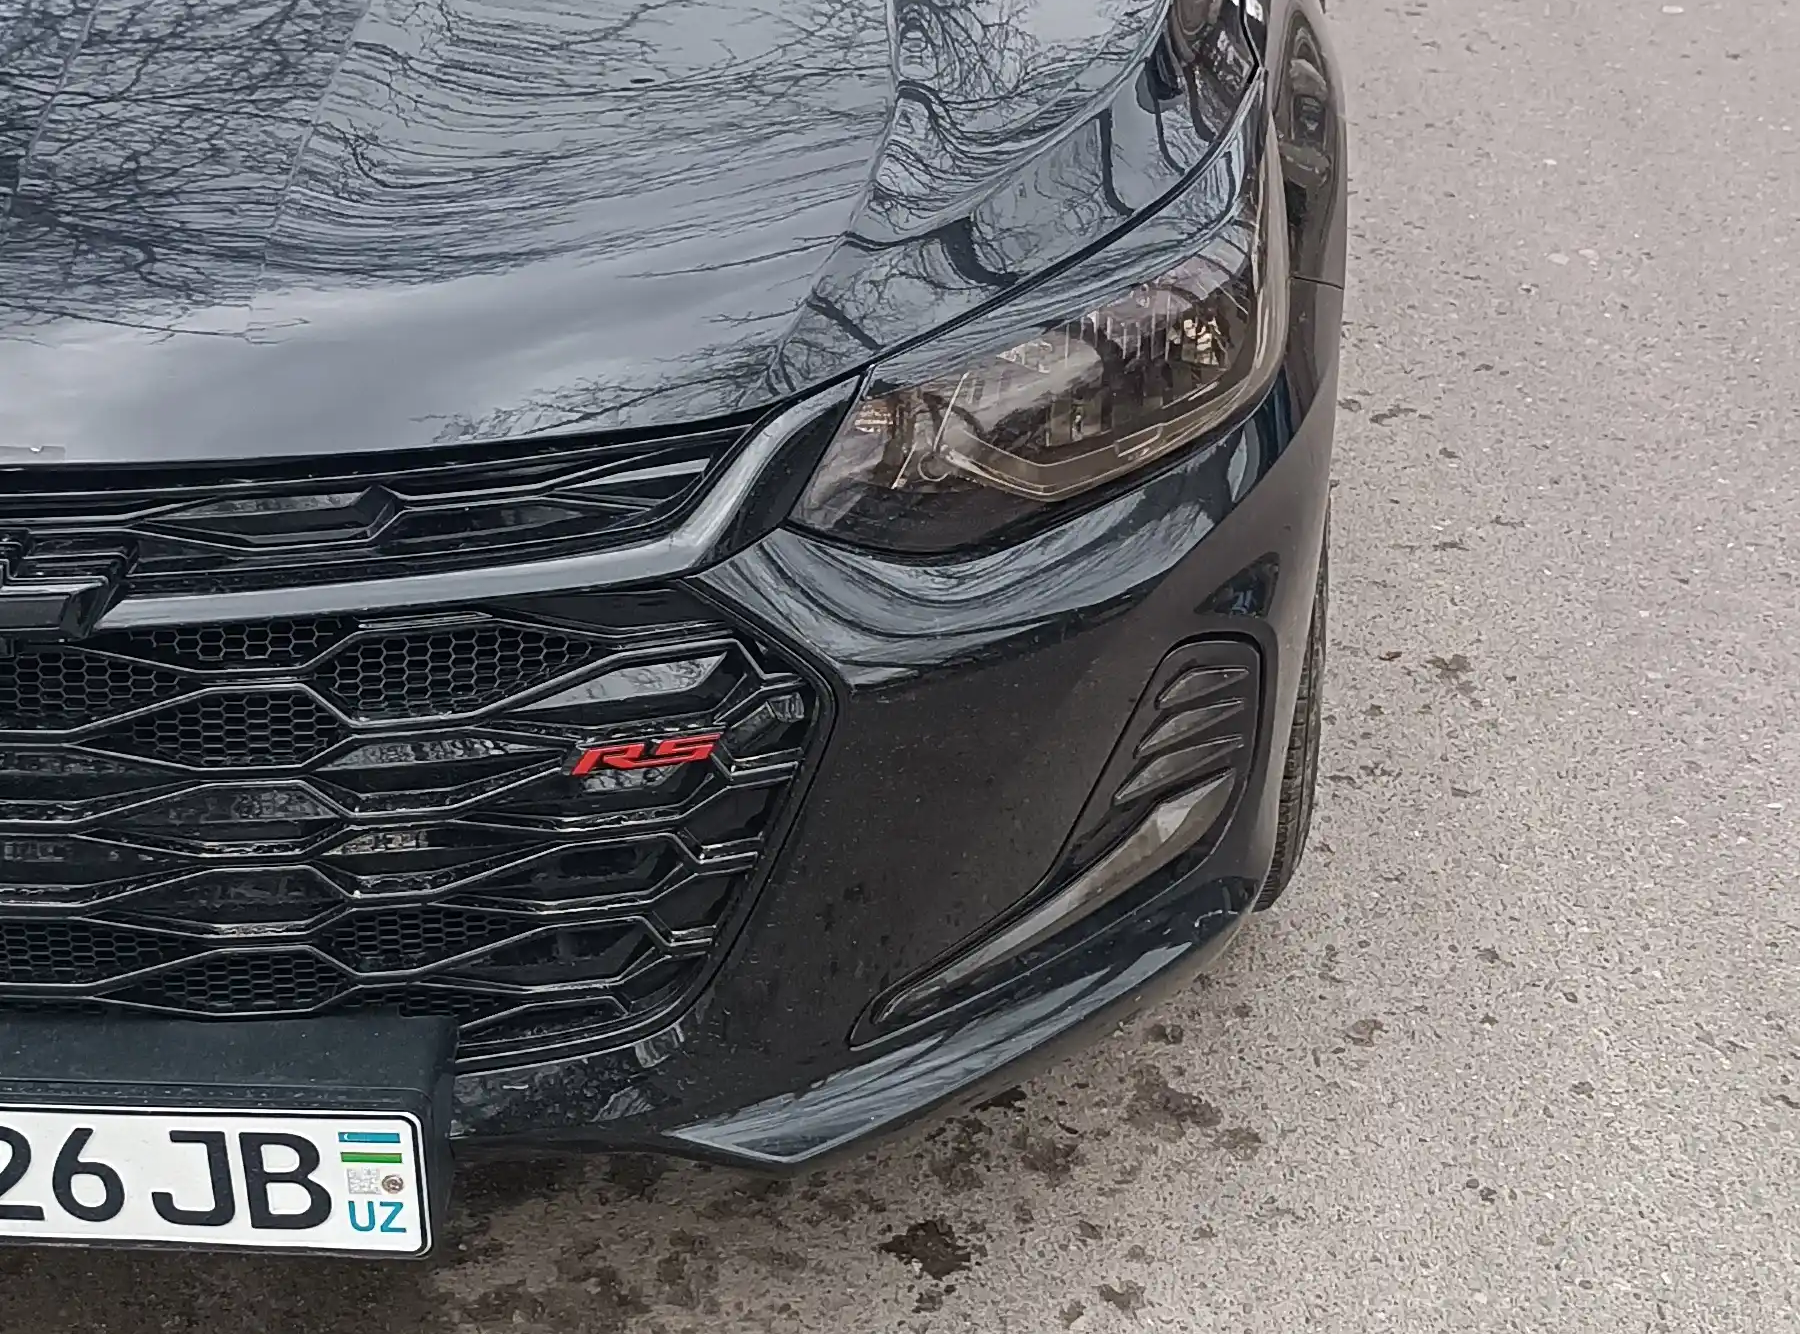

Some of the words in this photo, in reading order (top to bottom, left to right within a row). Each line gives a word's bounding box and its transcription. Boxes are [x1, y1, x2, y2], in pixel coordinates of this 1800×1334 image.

[572, 732, 722, 775] RS
[151, 1130, 333, 1230] JB
[348, 1200, 407, 1233] UZ
